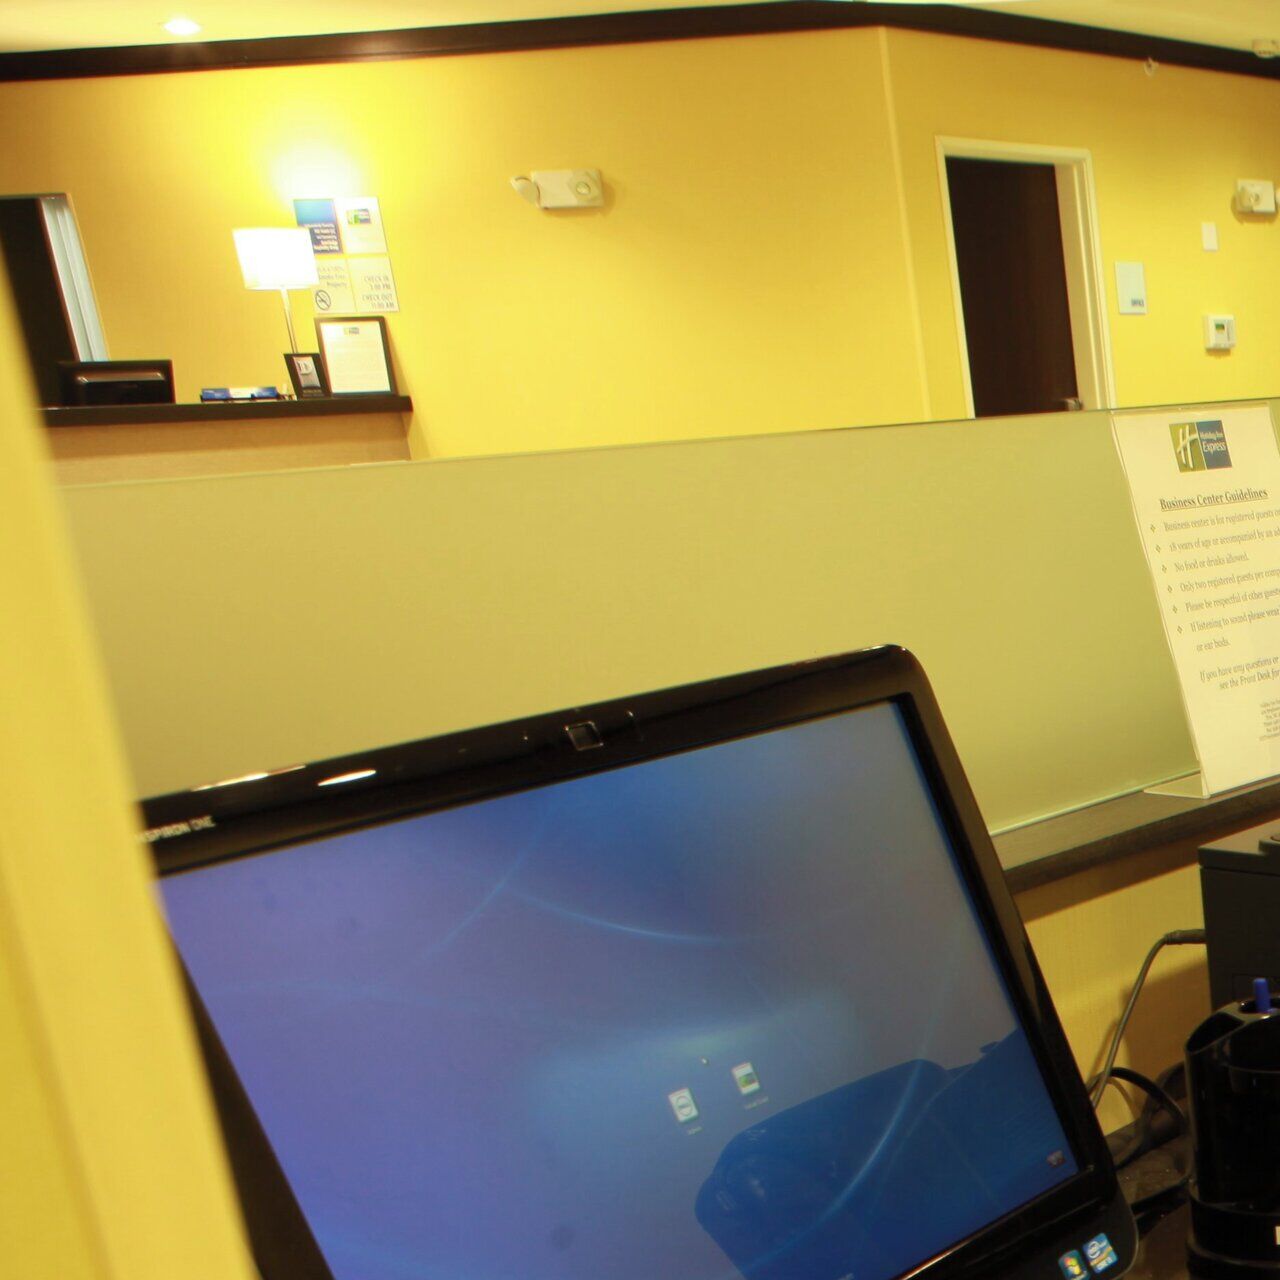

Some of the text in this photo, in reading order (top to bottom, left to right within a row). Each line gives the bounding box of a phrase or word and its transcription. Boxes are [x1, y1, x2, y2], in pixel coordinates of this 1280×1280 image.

[1203, 441, 1226, 454] Express
[1160, 488, 1268, 511] Business Center Guidelines
[1163, 520, 1190, 531] Business
[1190, 518, 1209, 528] center
[1216, 514, 1225, 525] for
[1226, 511, 1254, 525] registered
[1255, 511, 1274, 522] guests
[1177, 542, 1194, 553] years
[1194, 538, 1200, 549] of
[1201, 540, 1211, 550] age
[1220, 530, 1257, 544] accompanied
[1257, 529, 1265, 541] by
[1265, 530, 1273, 538] an
[1174, 552, 1250, 572] No food or drinks allowed.
[1180, 581, 1194, 592] Only
[1195, 581, 1207, 589] two
[1207, 573, 1235, 589] registered
[1236, 572, 1254, 584] guests
[1255, 571, 1264, 582] per
[1185, 588, 1280, 612] Please be respectful of other guests
[1190, 622, 1196, 632] If
[1196, 618, 1222, 631] listening
[1222, 617, 1229, 625] to
[1230, 612, 1248, 624] sound
[1247, 610, 1265, 623] please
[1204, 642, 1213, 650] ear
[1200, 671, 1206, 683] If
[1206, 671, 1217, 682] you
[1217, 667, 1231, 677] have
[1232, 664, 1245, 674] any
[1245, 658, 1272, 672] questions
[1272, 656, 1279, 664] or
[1219, 681, 1229, 690] see
[1229, 677, 1239, 688] the
[1240, 675, 1256, 687] Front
[1257, 669, 1271, 681] Desk
[1271, 668, 1280, 680] for
